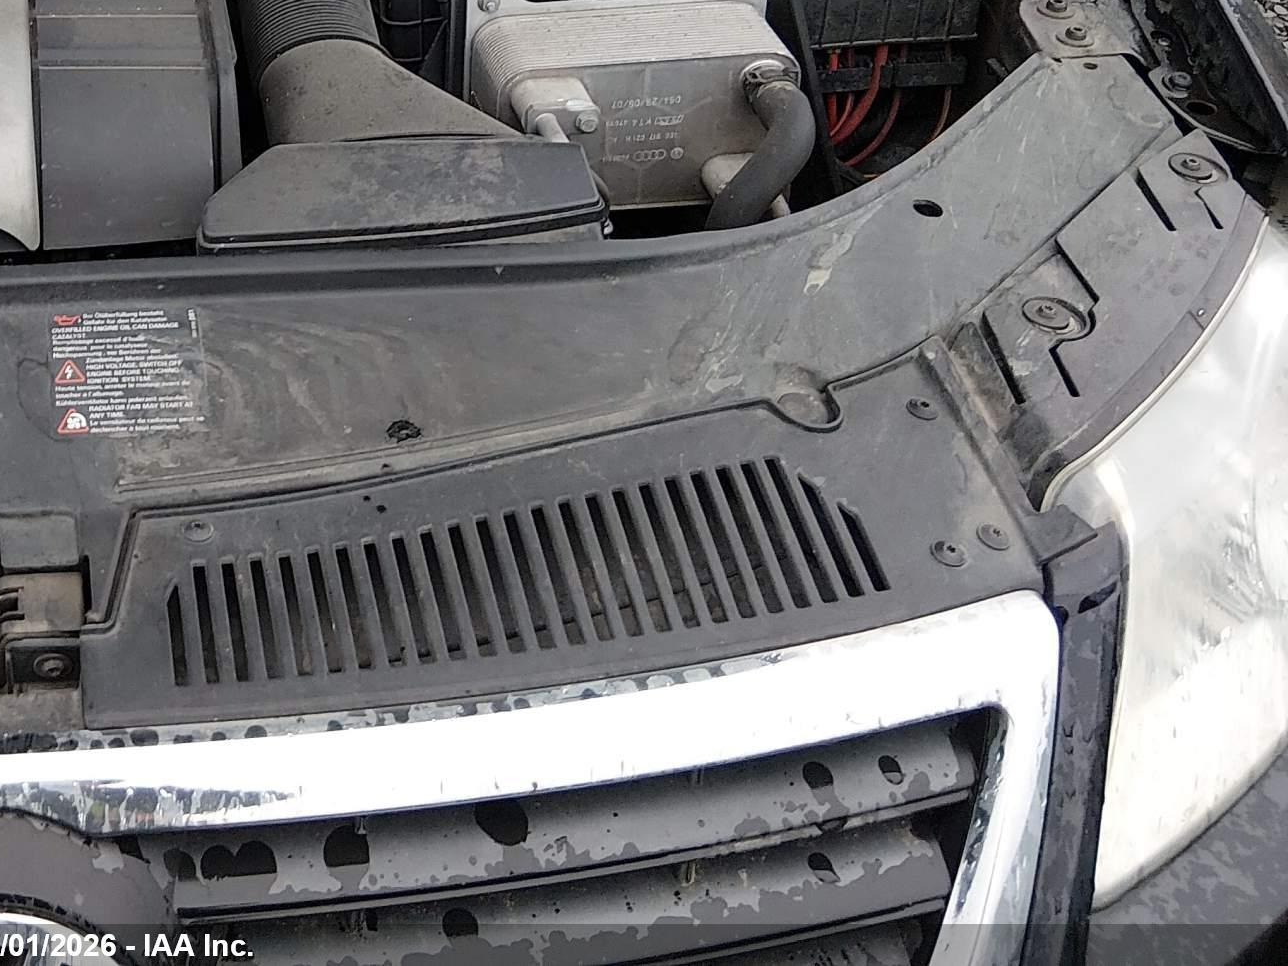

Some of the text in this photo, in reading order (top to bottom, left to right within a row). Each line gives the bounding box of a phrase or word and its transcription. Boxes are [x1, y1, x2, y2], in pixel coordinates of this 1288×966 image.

[51, 326, 92, 334] OVERFILLED
[88, 404, 125, 412] RADIATOR
[159, 401, 182, 409] START
